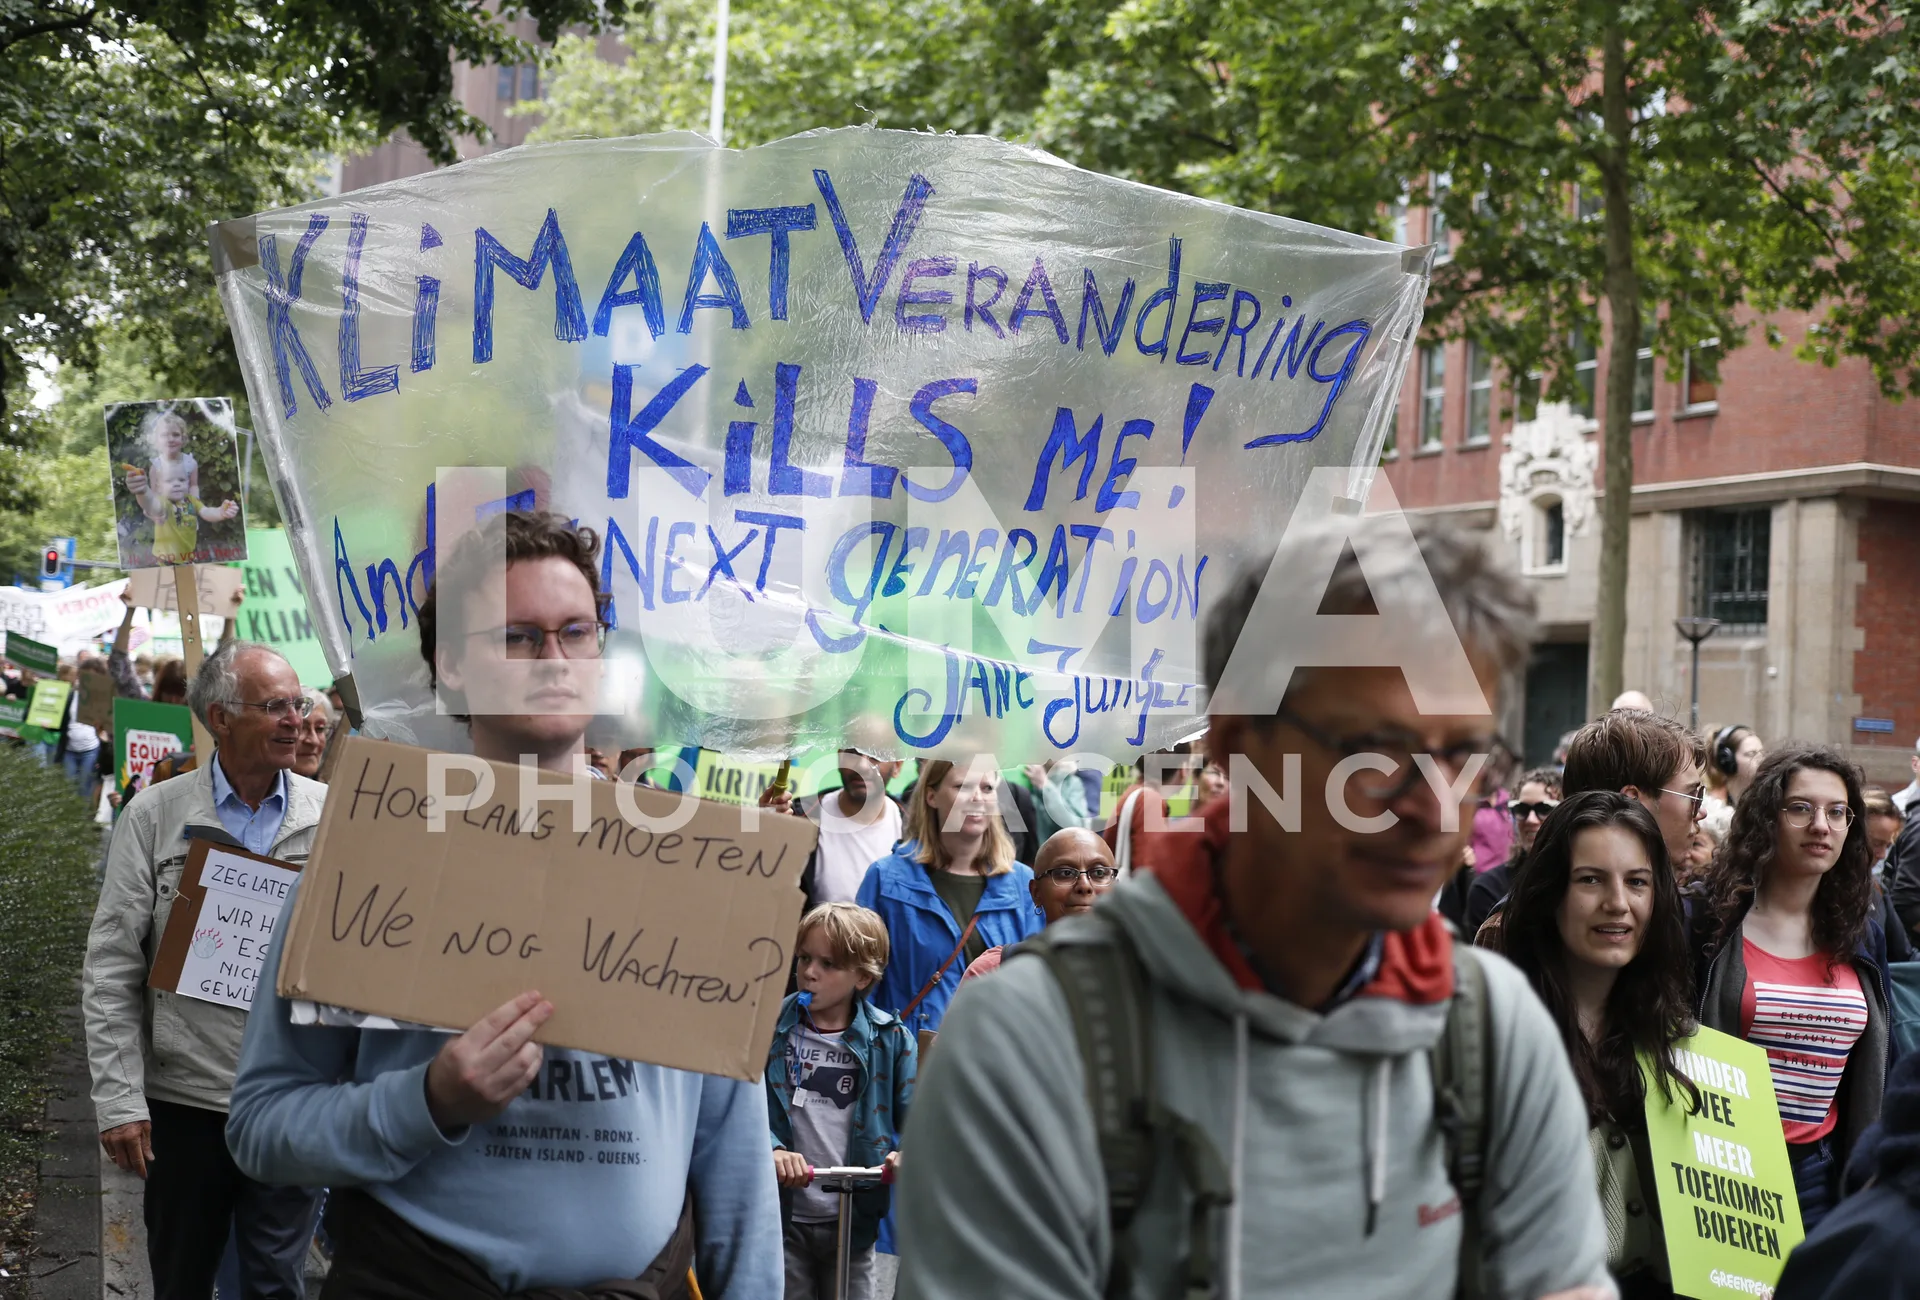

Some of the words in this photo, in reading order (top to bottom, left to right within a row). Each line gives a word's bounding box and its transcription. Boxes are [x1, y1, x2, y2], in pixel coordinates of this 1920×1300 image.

[600, 508, 806, 631] NEXT
[130, 742, 177, 760] EQUA
[211, 864, 249, 888] ZEG
[217, 904, 253, 928] WIR
[1781, 1012, 1851, 1025] ELEGANCE
[1784, 1032, 1837, 1044] BEAUTY
[1783, 1055, 1828, 1070] TRUTH
[497, 1125, 581, 1143] MANHATTAN
[594, 1130, 634, 1143] BRONX
[484, 1144, 532, 1161] STATEN
[536, 1147, 585, 1164] ISLAND
[597, 1150, 642, 1165] QUEENS
[1693, 1130, 1756, 1179] MEER
[1671, 1161, 1785, 1225] TOEKOMST
[1693, 1205, 1782, 1261] BOEREN
